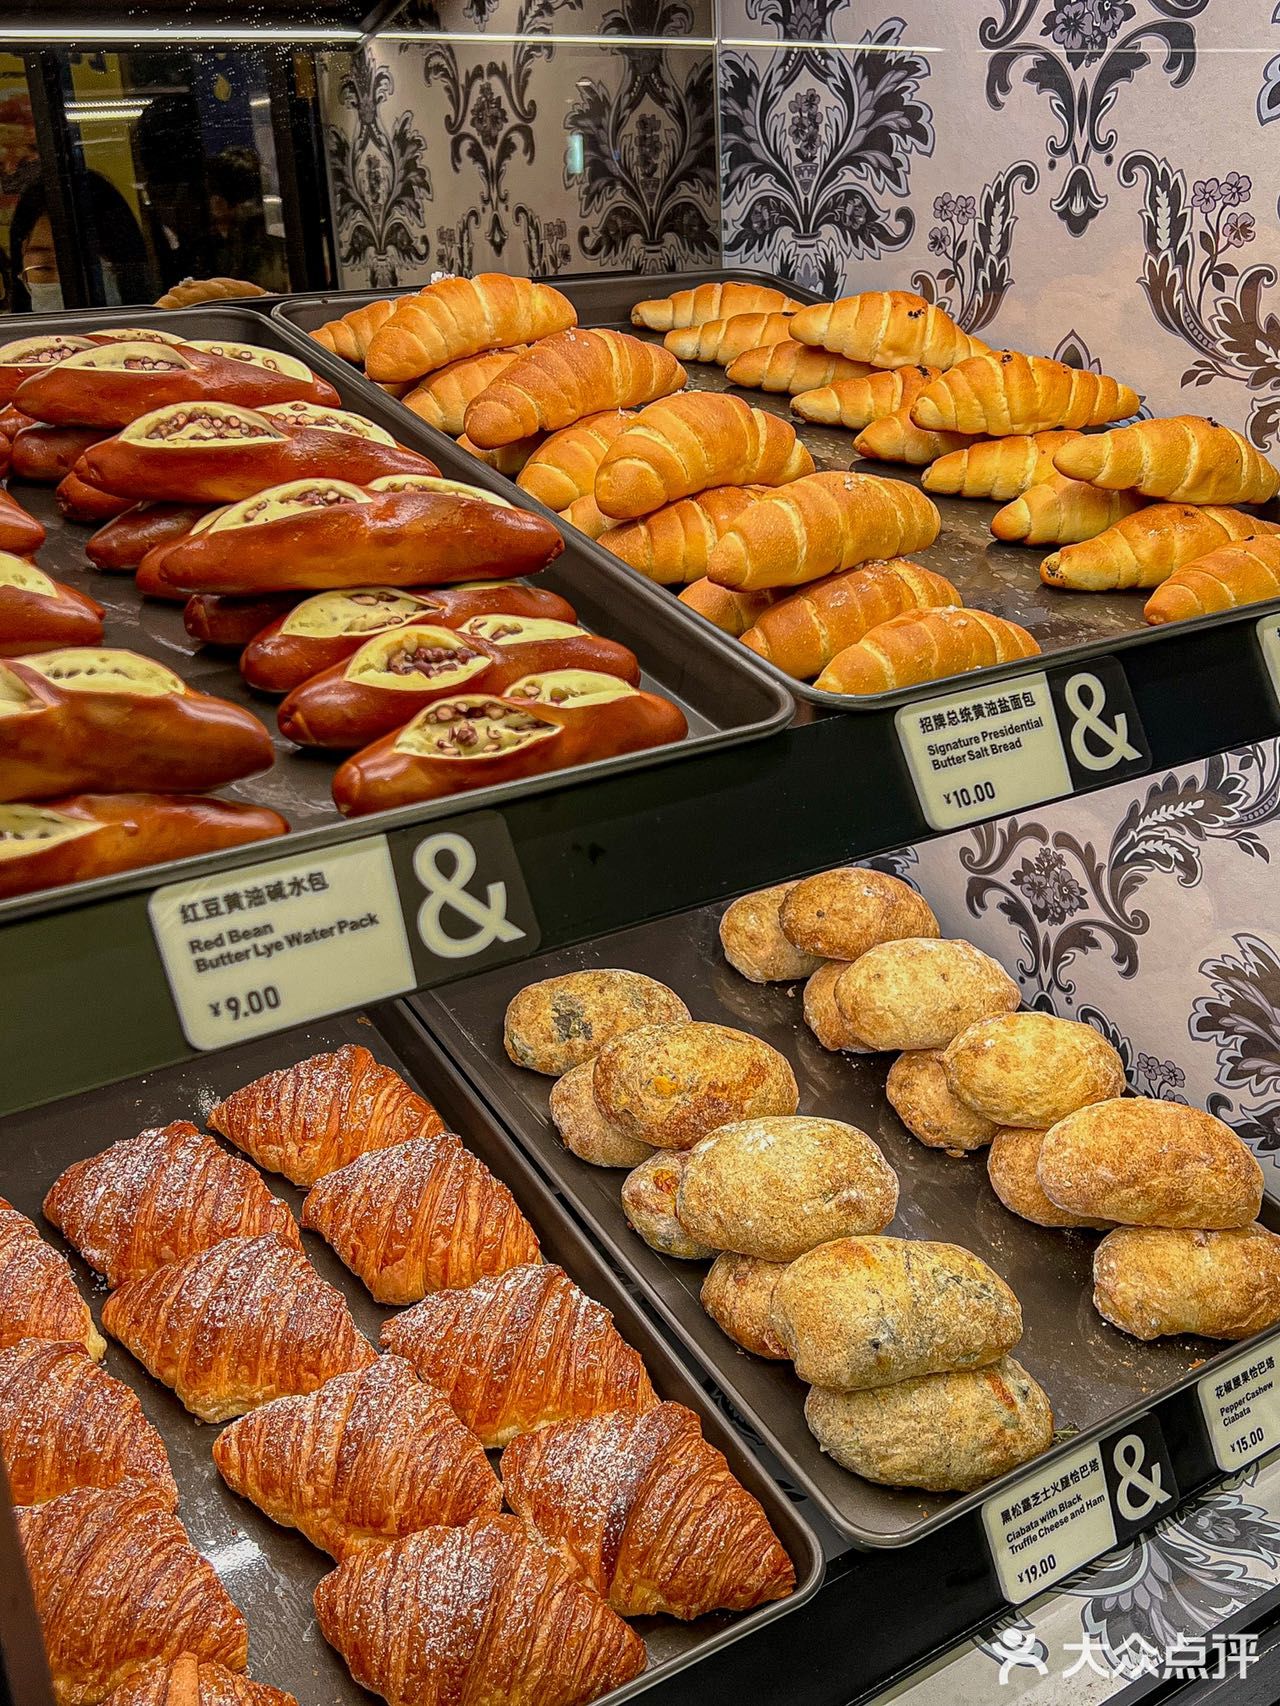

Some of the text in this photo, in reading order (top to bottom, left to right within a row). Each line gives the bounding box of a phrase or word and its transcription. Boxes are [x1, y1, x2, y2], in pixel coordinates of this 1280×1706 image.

[918, 691, 1036, 734] 招牌总统黄油盐面包
[1065, 672, 1143, 771] &
[927, 716, 1044, 757] Signature Presidential
[932, 738, 1023, 771] Butter Salt Bread
[943, 781, 996, 809] ¥10.00
[179, 871, 330, 925] 红豆黄油碱水包
[413, 832, 527, 958] &
[188, 920, 274, 954] Red Bean
[194, 911, 379, 973] Butter Lye Water Pack
[208, 985, 281, 1021] ¥9.00
[1215, 1356, 1275, 1400] 花椒腰果恰巴塔
[1220, 1380, 1274, 1417] Pepper Cashew
[1222, 1406, 1251, 1427] Ciabata
[1230, 1427, 1264, 1454] ¥15.00
[1000, 1458, 1100, 1526] 黑松露芝士火腿恰巴塔
[1113, 1434, 1173, 1521] &
[1006, 1493, 1083, 1543] Ciabata with Black
[1008, 1494, 1105, 1555] Truffle Cheese and Ham
[1017, 1554, 1057, 1585] ¥19.00
